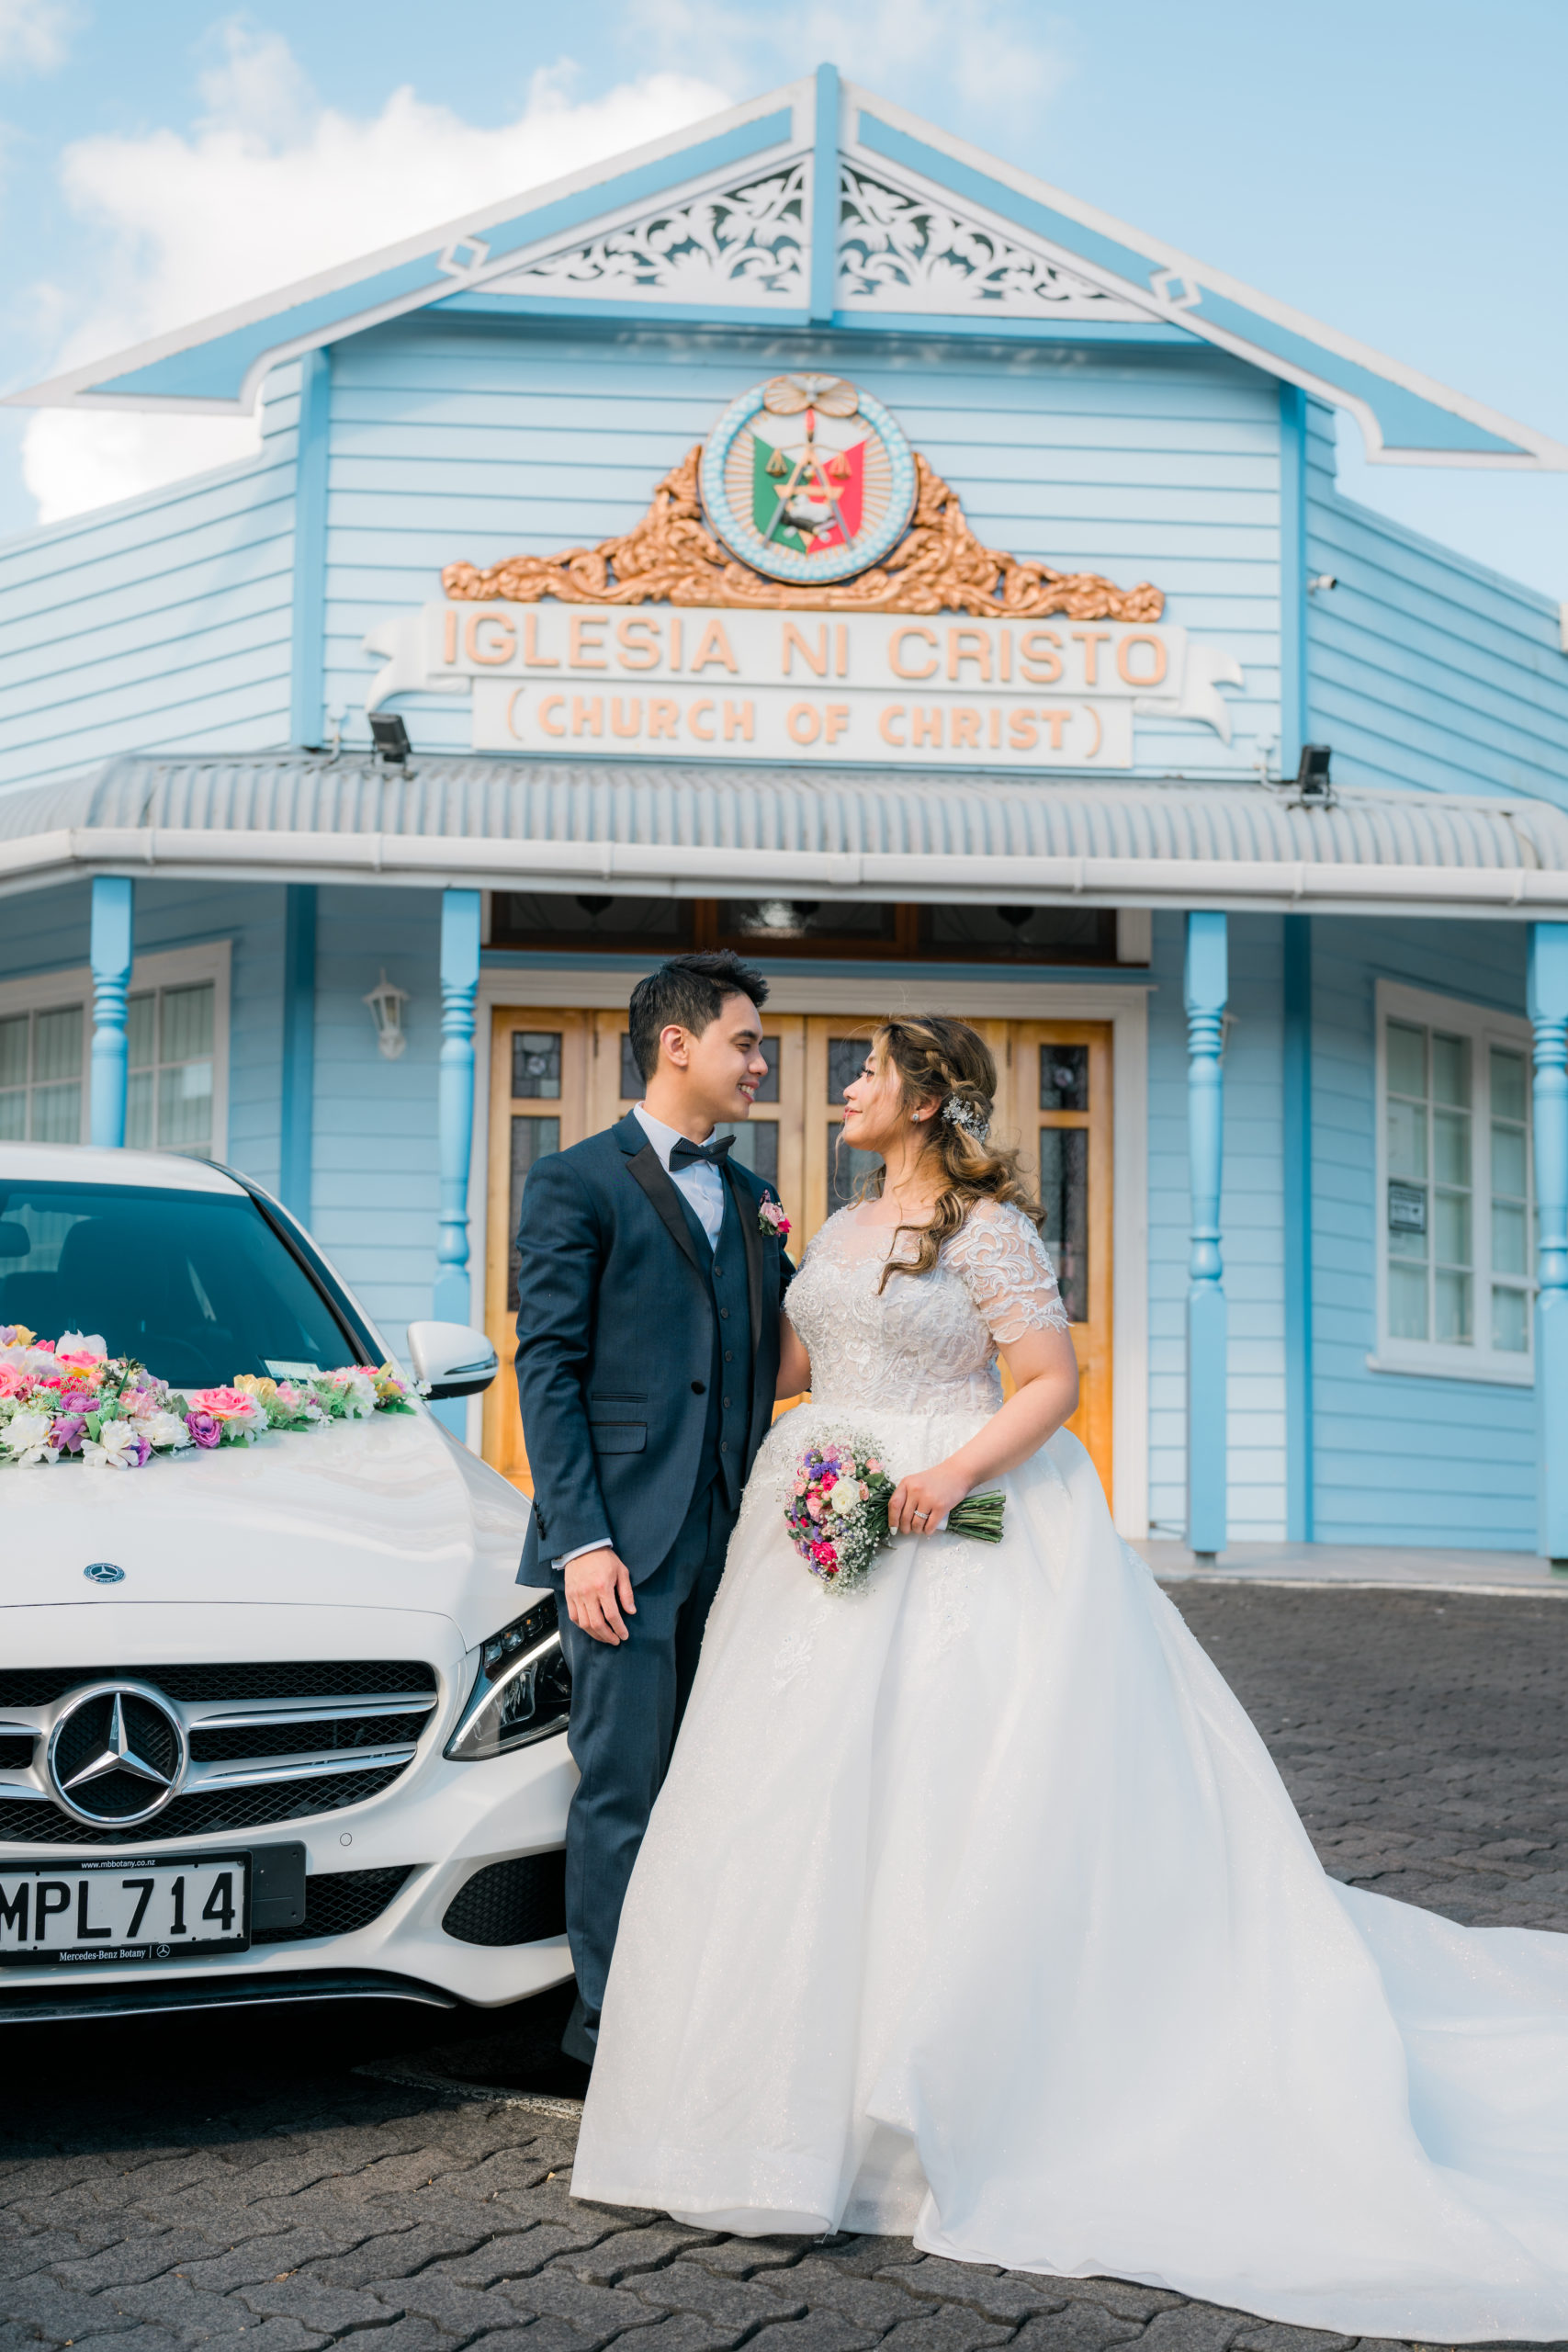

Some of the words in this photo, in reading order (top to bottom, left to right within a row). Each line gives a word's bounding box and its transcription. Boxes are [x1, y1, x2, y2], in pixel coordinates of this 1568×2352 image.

[444, 610, 739, 673] IGLESIA
[782, 622, 848, 677] NI
[888, 626, 1168, 686] CRISTO
[786, 702, 850, 745] OF
[81, 1859, 156, 1870] www.mbbotany.co.nz
[0, 1871, 236, 1941] MPL714
[59, 1950, 118, 1962] Mercedes-Benz
[119, 1949, 146, 1960] Botany
